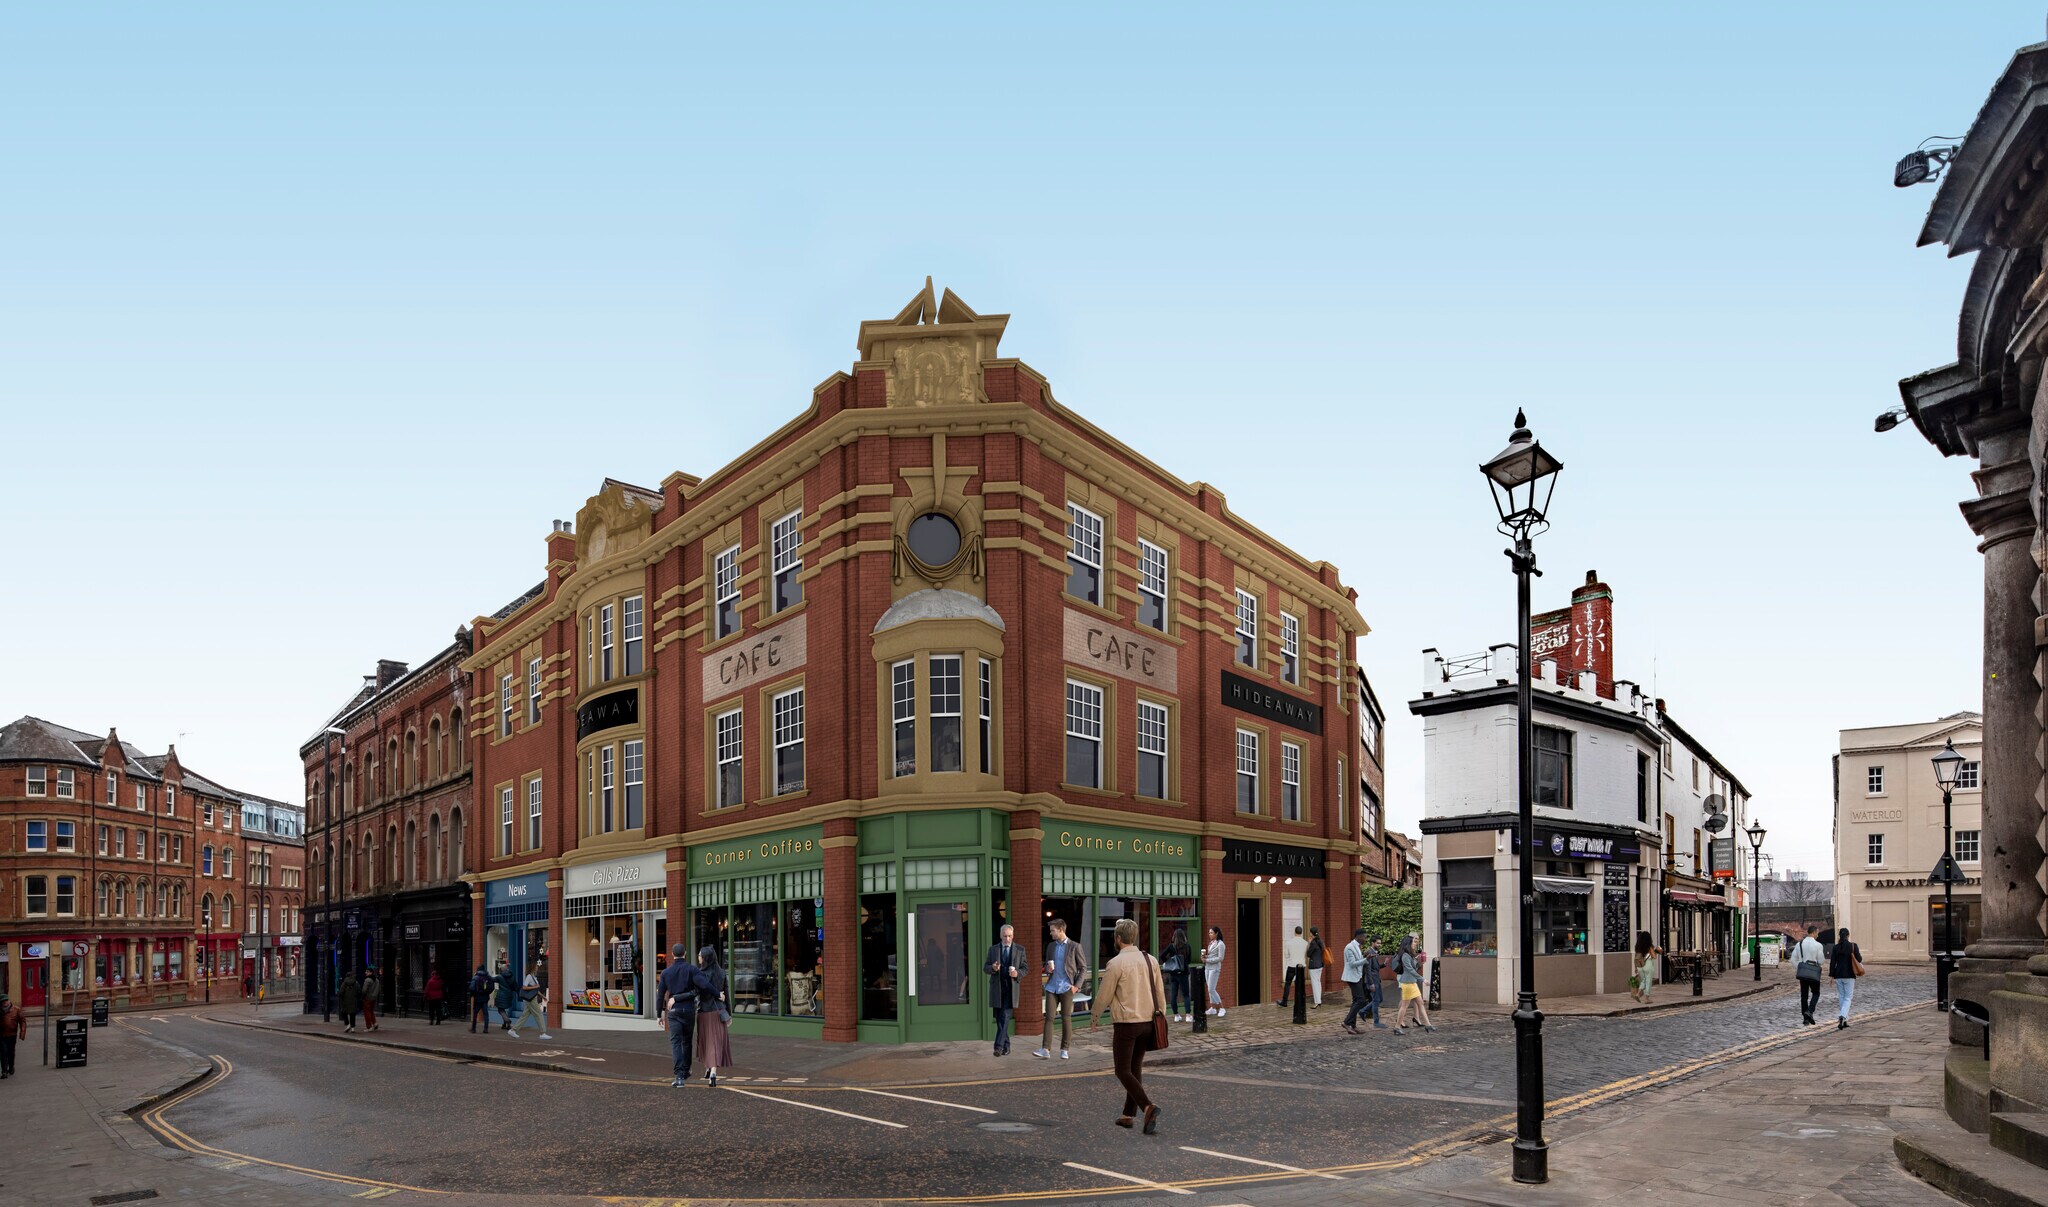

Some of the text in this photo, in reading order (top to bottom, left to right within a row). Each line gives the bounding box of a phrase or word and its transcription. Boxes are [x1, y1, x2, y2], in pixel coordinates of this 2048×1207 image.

[1584, 603, 1595, 669] CARAVANSERA
[720, 635, 783, 685] CAFE
[1087, 628, 1156, 677] CAFE
[1233, 684, 1313, 723] HIDEAWAY
[1852, 809, 1902, 821] WATERLOO
[705, 839, 813, 866] Corner Coffee
[1060, 831, 1183, 856] Corner Coffee
[1569, 836, 1587, 852] JUST
[1234, 848, 1315, 868] HIDEAWAY
[592, 864, 640, 886] Calls Pizza
[508, 884, 527, 897] News
